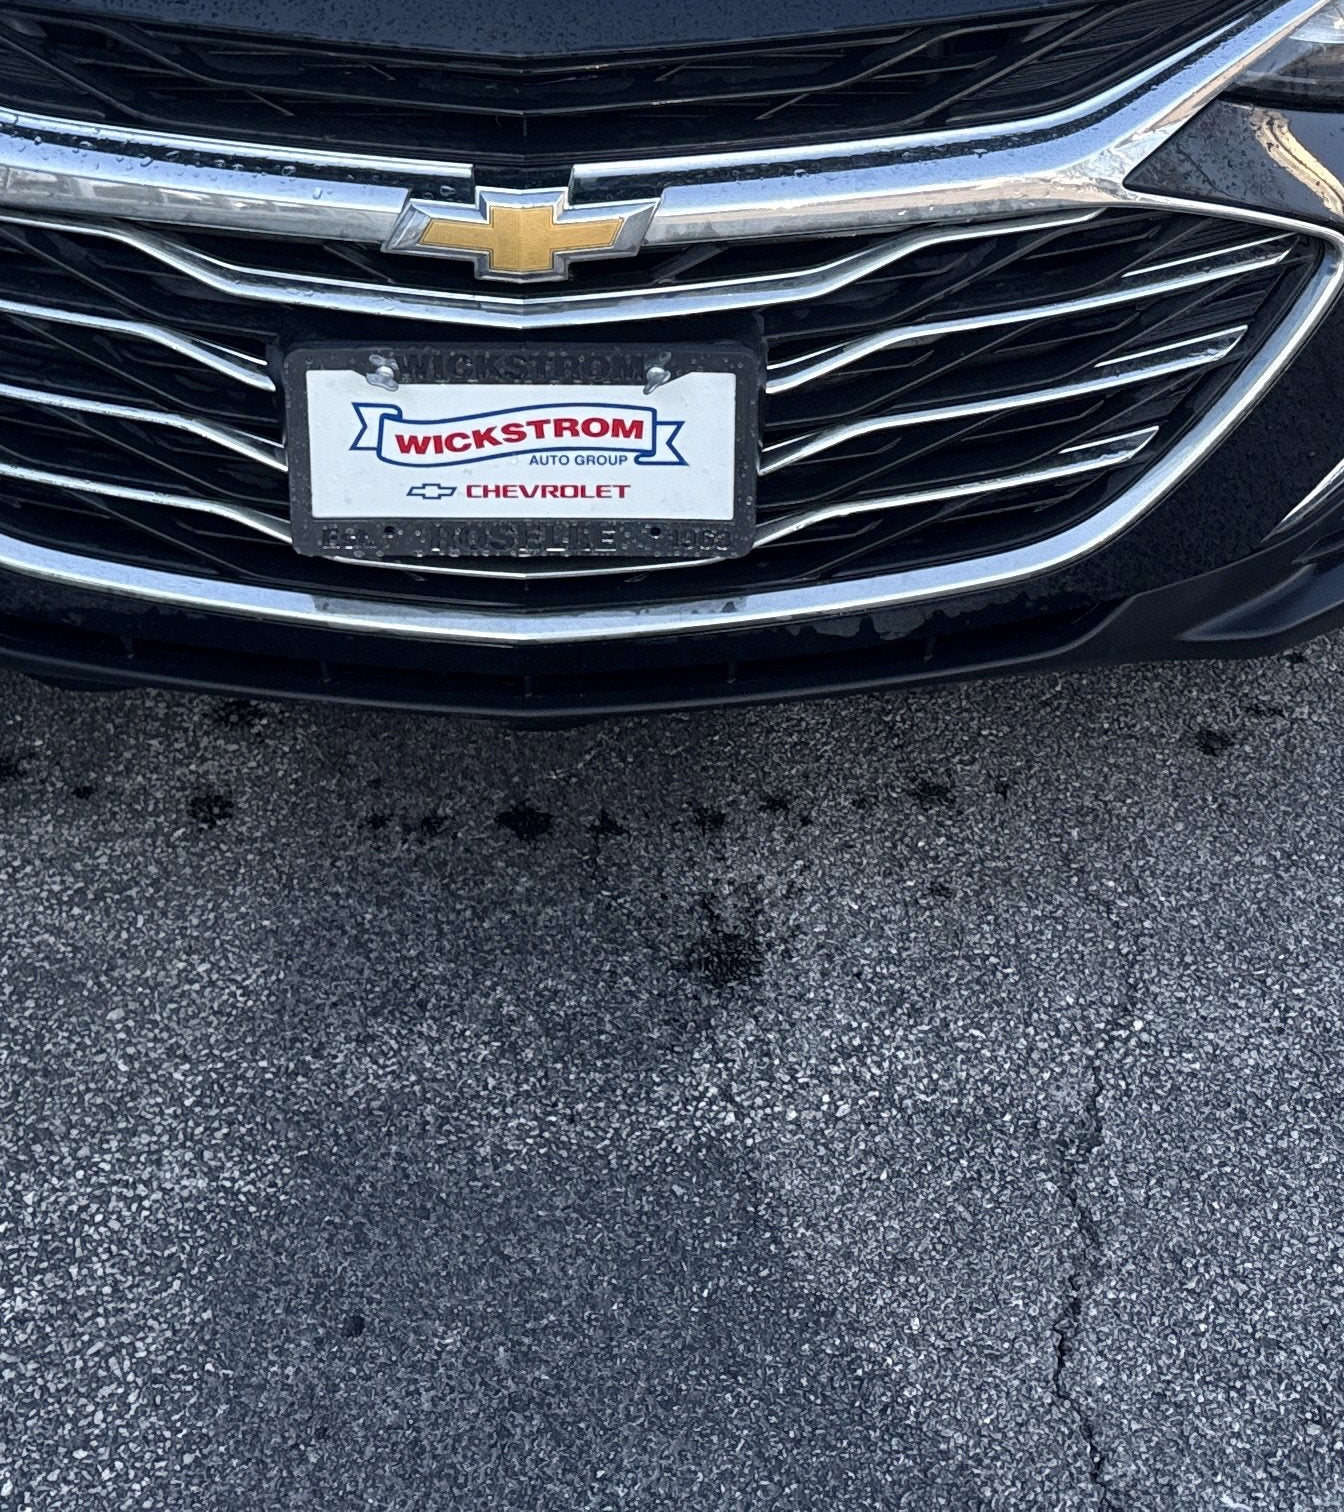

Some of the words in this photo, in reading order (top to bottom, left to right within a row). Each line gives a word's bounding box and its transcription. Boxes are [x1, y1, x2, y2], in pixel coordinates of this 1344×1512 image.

[396, 353, 646, 382] WICKSTROM
[395, 417, 644, 455] WICKSTROM
[529, 454, 570, 466] AUTO
[574, 454, 628, 466] GROUP
[466, 484, 631, 499] CHEVROLET
[430, 525, 617, 552] ROSELLE
